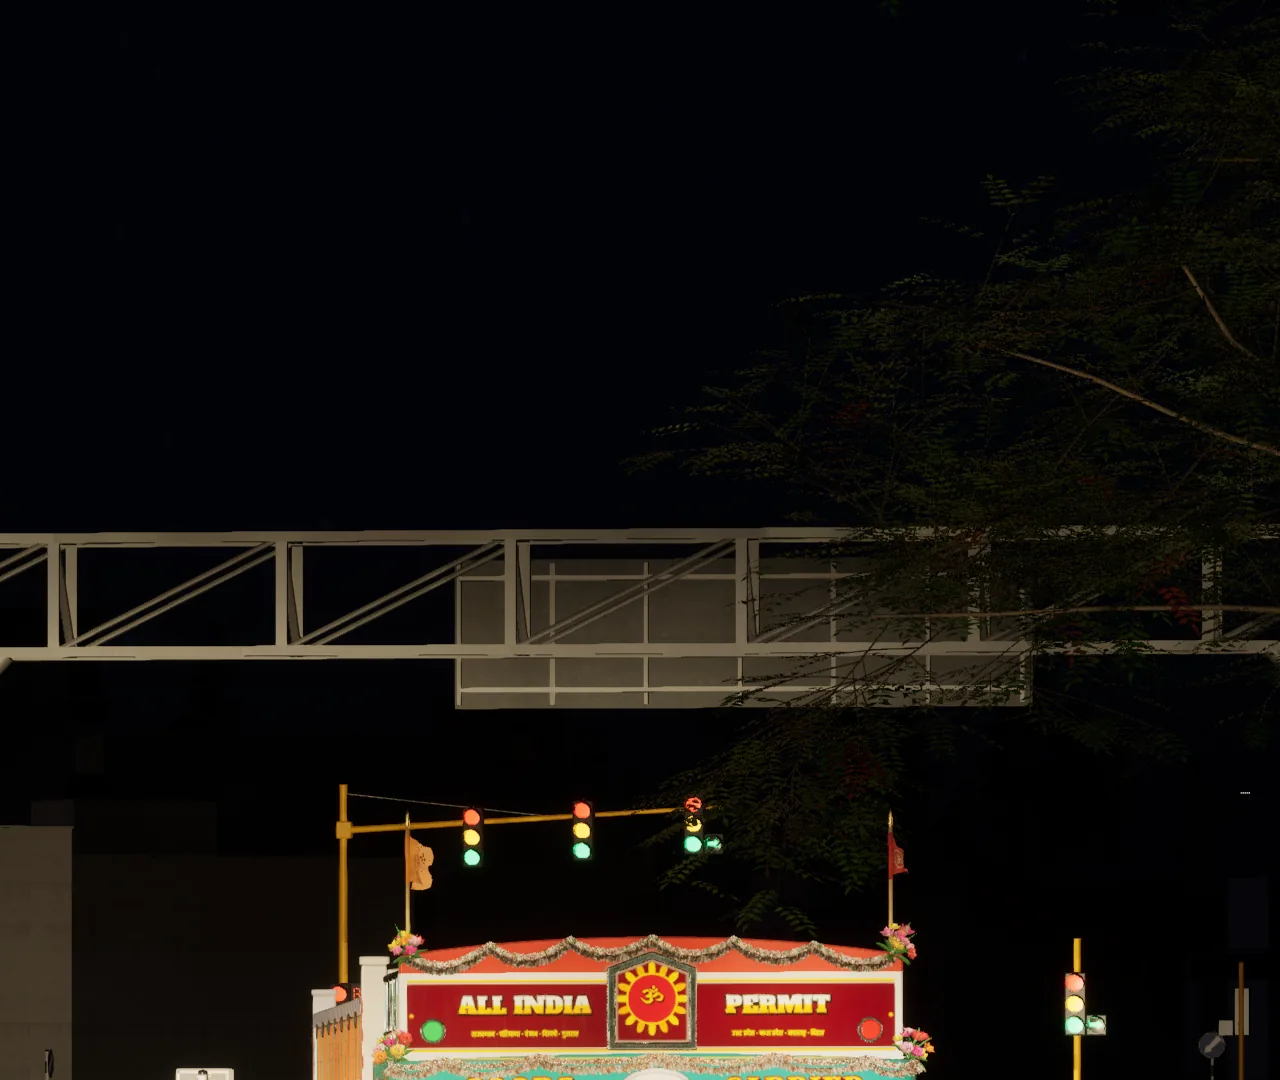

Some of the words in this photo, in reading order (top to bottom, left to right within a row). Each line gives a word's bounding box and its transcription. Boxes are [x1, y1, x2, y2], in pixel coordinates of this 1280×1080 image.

[458, 994, 508, 1015] ALL
[512, 994, 592, 1015] INDIA
[724, 993, 831, 1015] PERMIT
